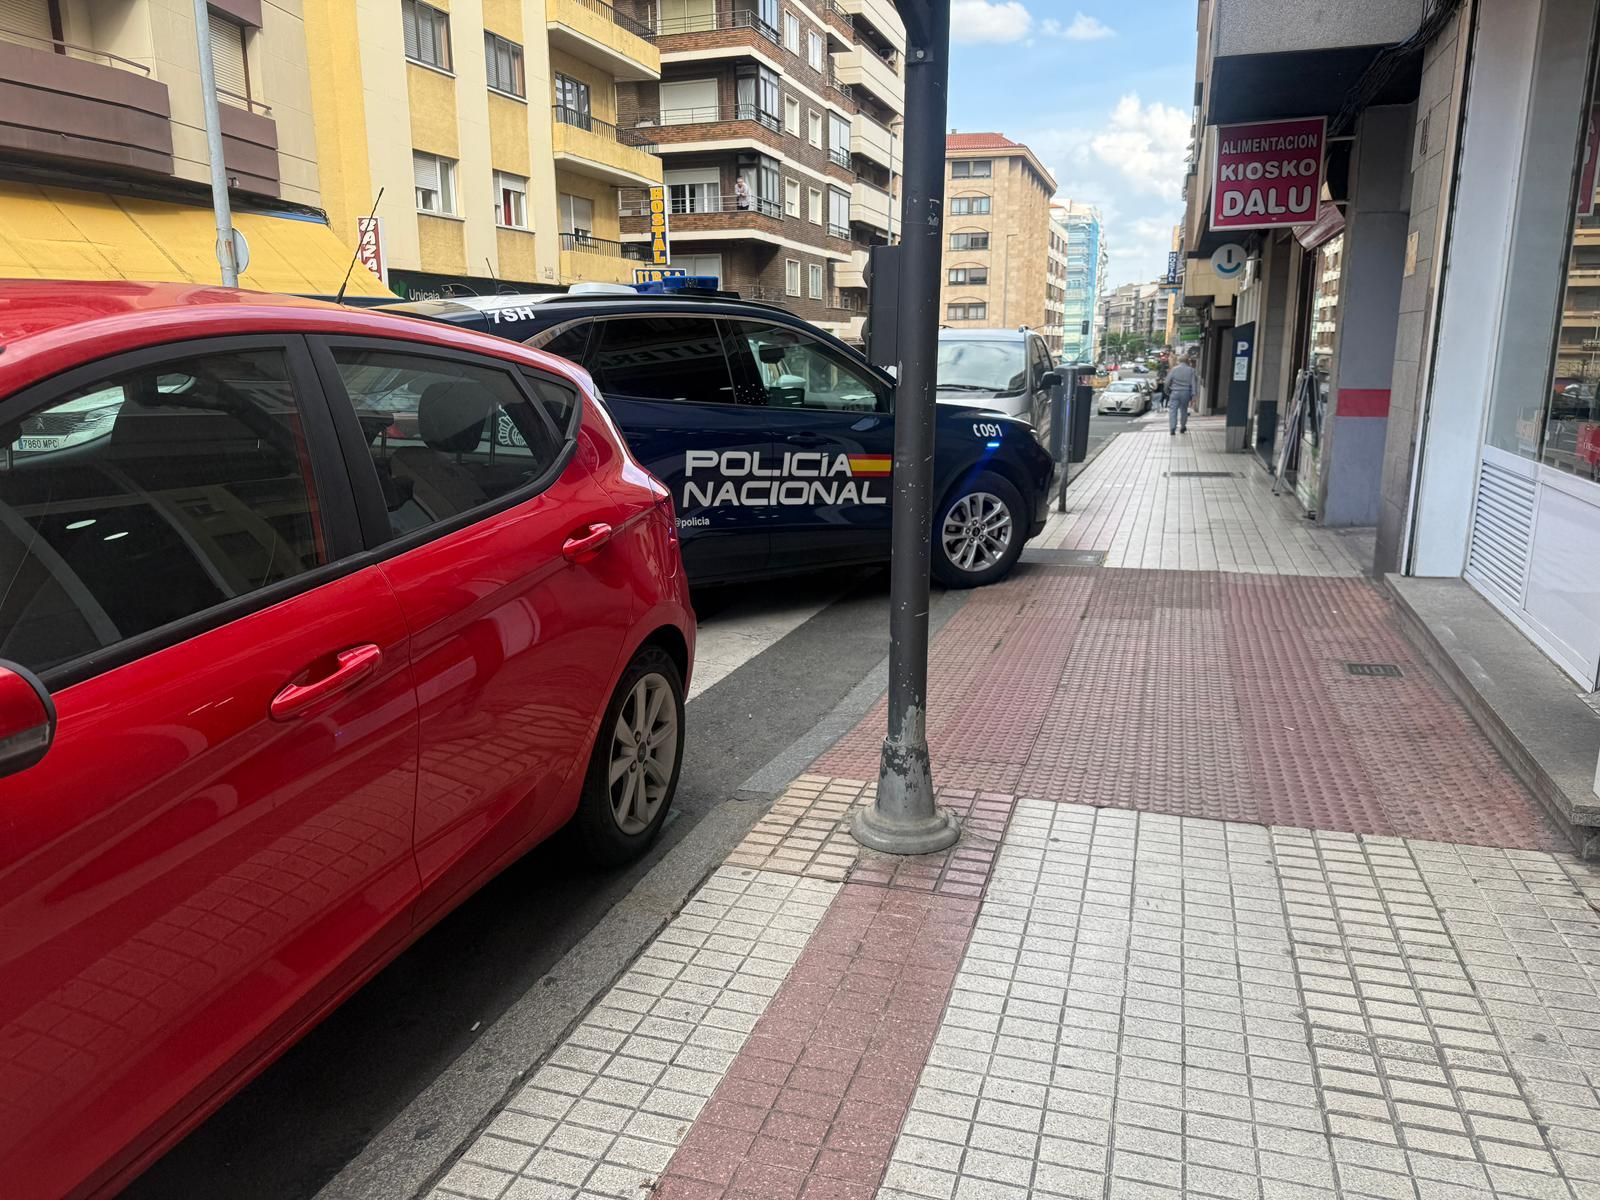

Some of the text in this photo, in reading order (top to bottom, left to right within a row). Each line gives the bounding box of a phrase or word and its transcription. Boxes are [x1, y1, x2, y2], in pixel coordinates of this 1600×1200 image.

[1220, 158, 1317, 182] KIOSKO
[1222, 185, 1312, 217] DALU
[649, 187, 666, 264] HOSTAL
[359, 219, 380, 279] BAZA
[1168, 252, 1177, 282] HOSTAL
[486, 306, 536, 324] 7SH
[1236, 341, 1249, 355] P
[23, 439, 58, 449] 7860 MPC
[682, 480, 887, 508] NACIONAL
